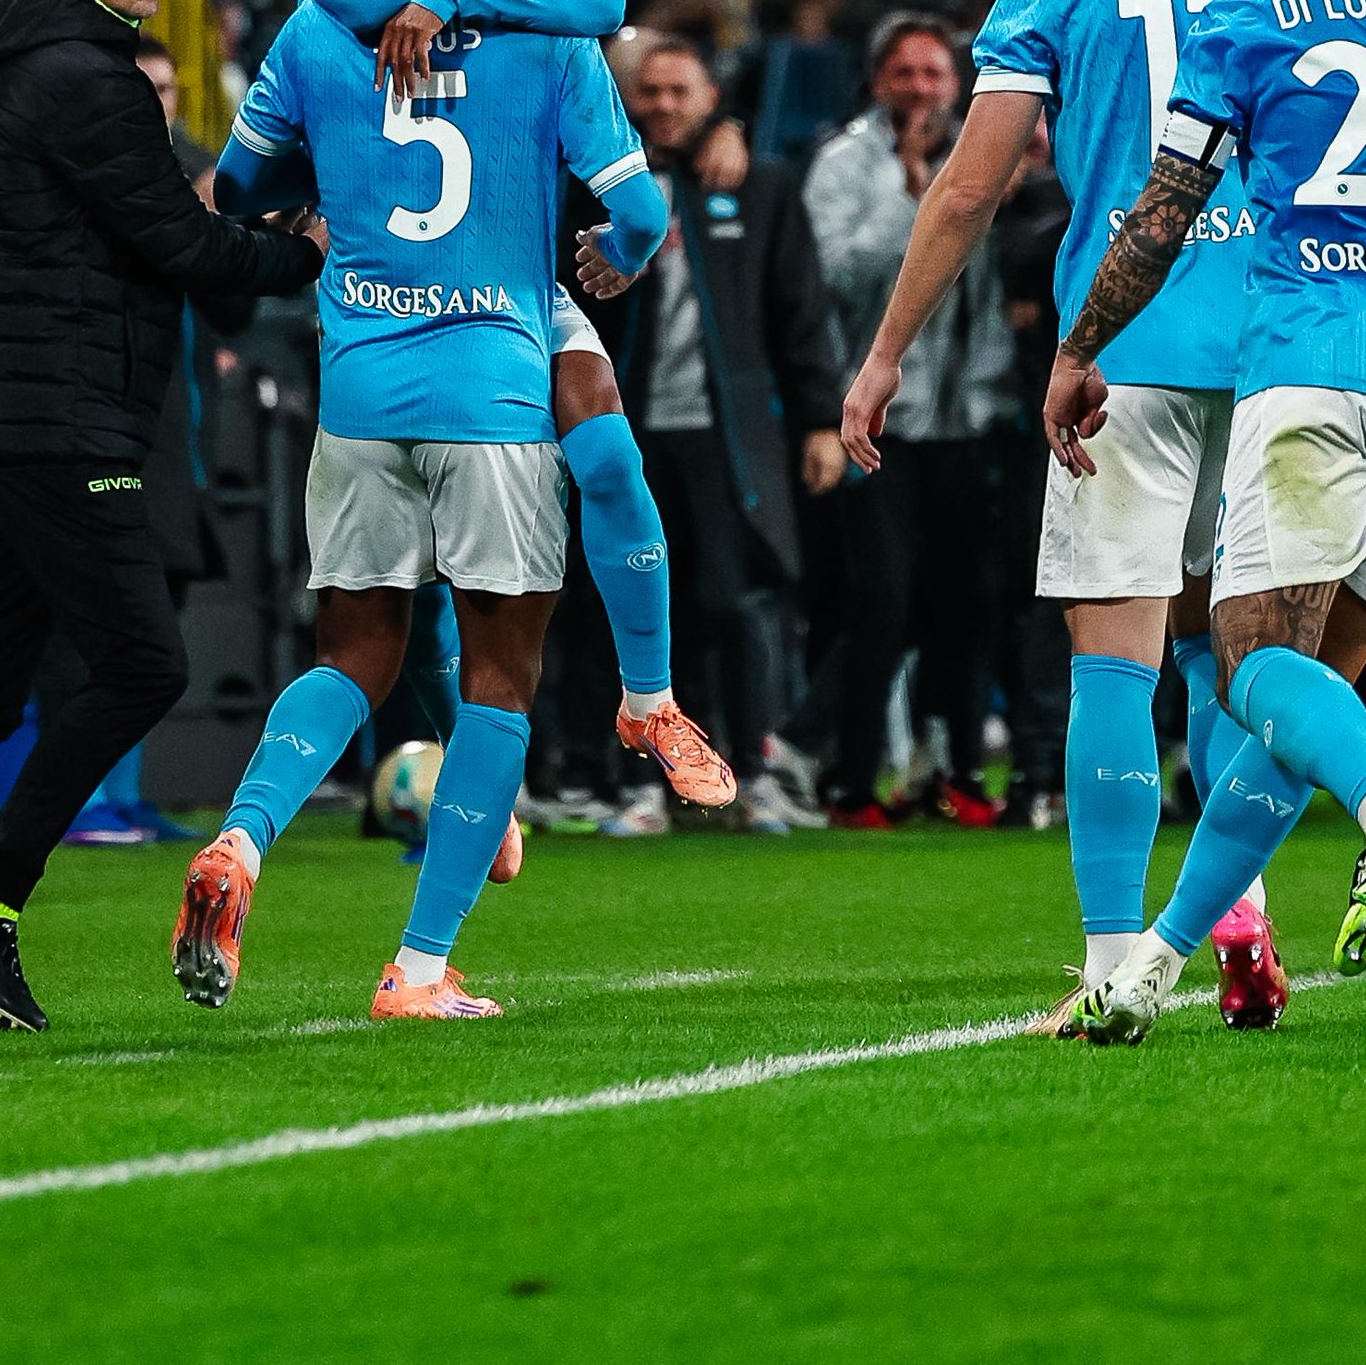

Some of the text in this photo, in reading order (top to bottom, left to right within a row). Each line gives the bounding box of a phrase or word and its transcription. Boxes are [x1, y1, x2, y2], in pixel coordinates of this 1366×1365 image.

[382, 70, 473, 243] 5
[342, 271, 513, 318] SORGESANA
[1229, 777, 1295, 819] EA7
